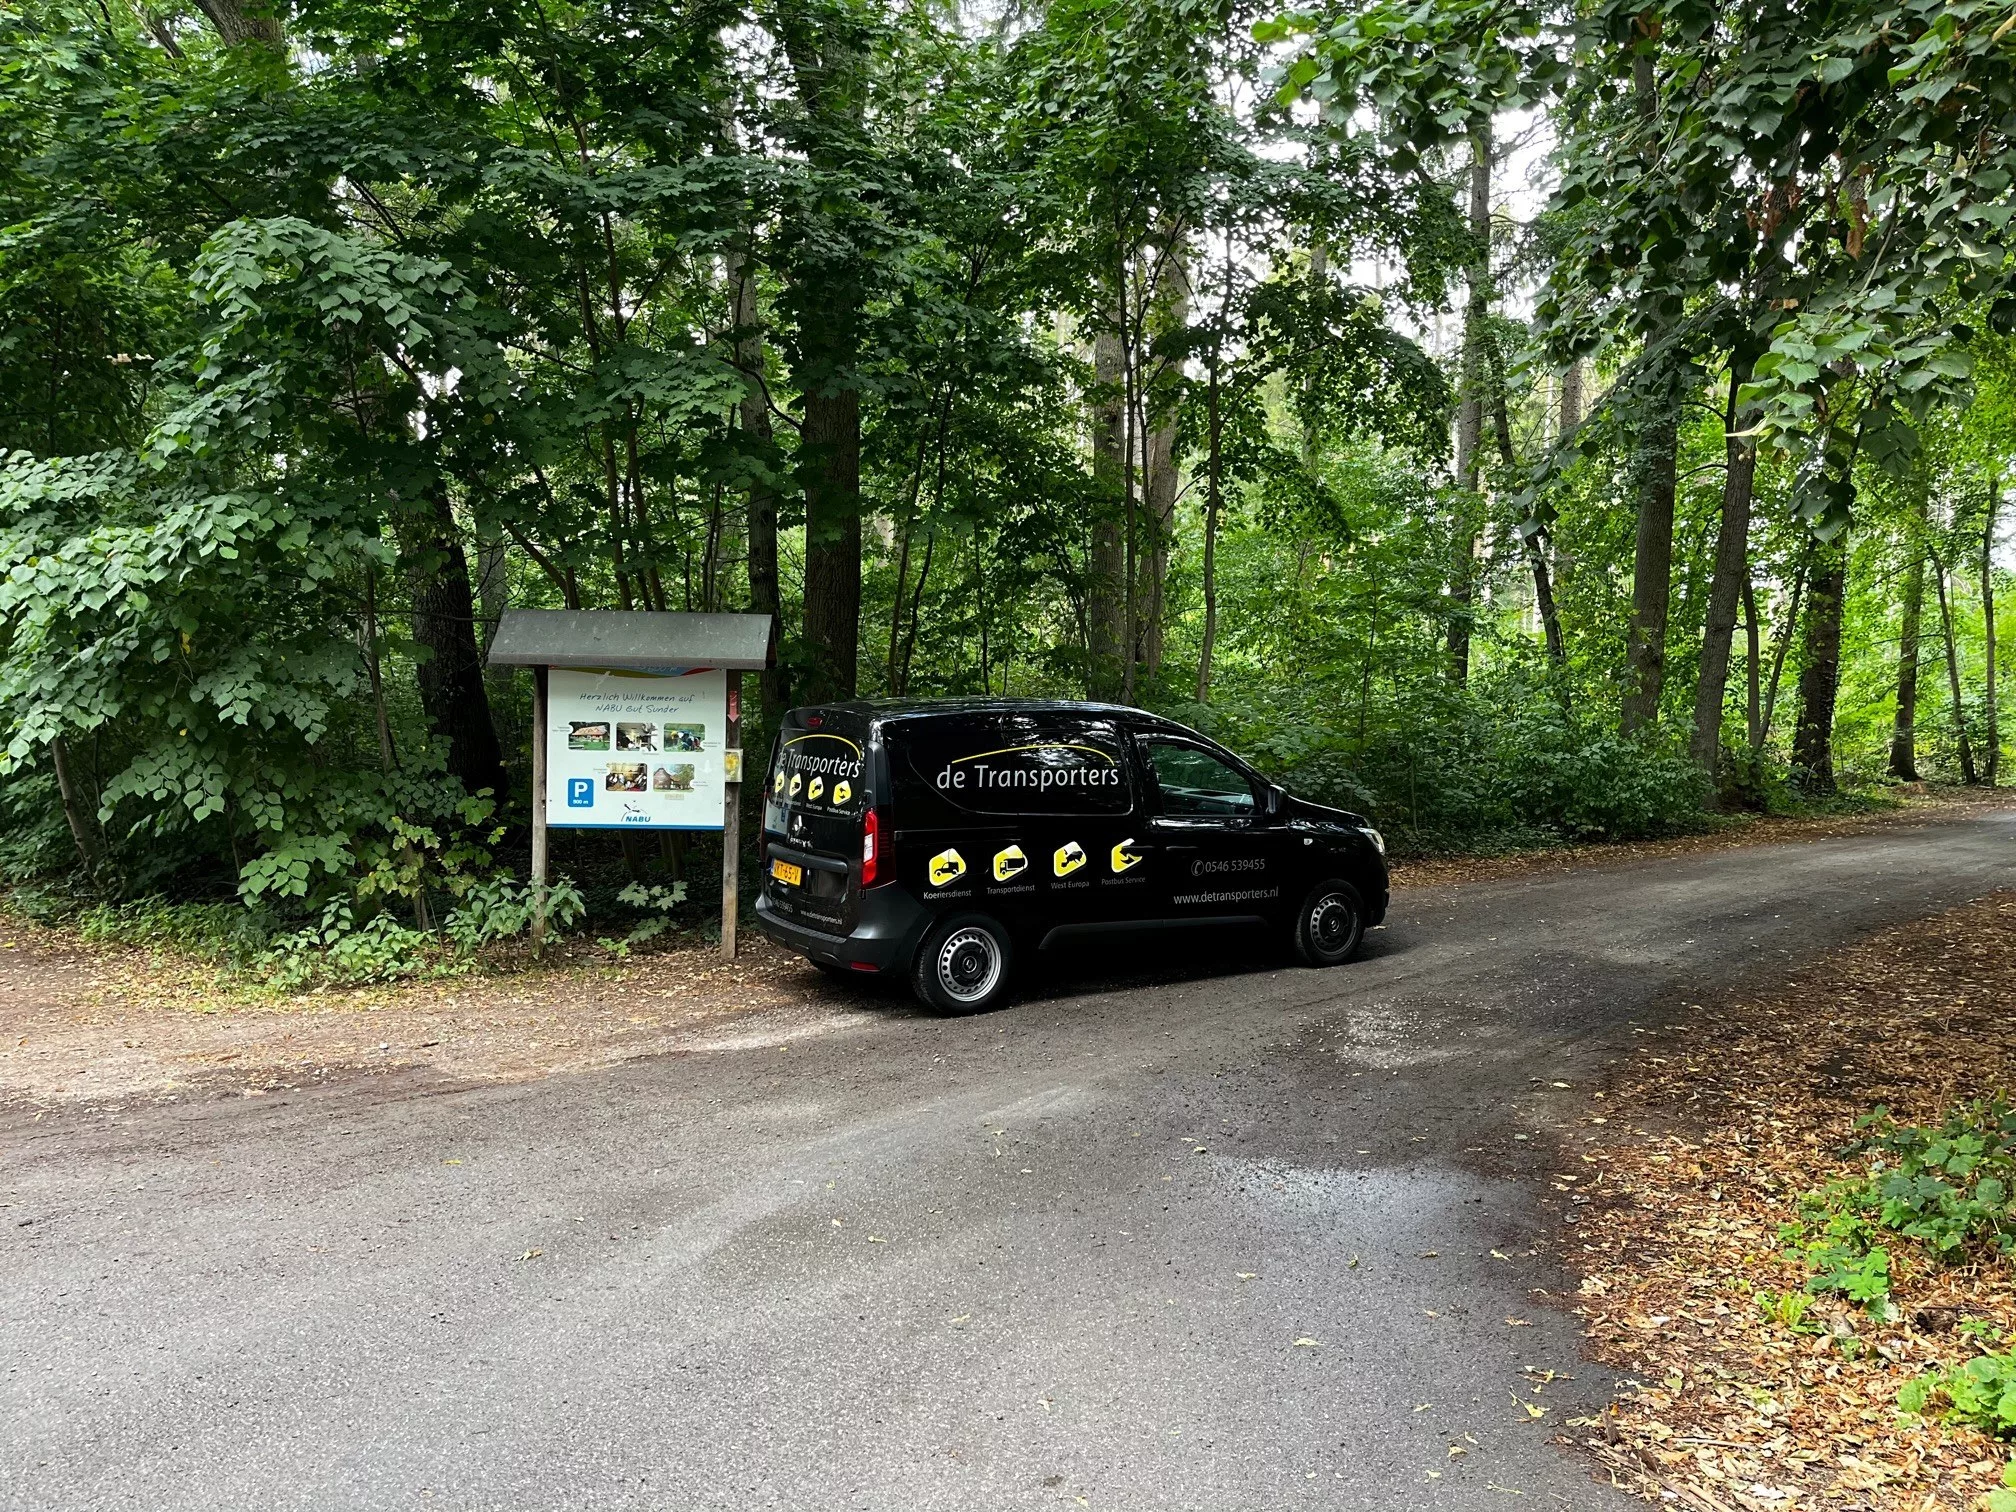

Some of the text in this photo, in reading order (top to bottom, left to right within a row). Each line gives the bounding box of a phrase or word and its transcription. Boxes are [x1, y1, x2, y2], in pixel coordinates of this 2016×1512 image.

[579, 693, 695, 703] Herzlich Willkommen auf
[595, 704, 679, 713] NABU Gut Sunder
[787, 748, 861, 778] Transporters
[936, 765, 1119, 792] de Transporters
[574, 781, 588, 798] P
[1205, 858, 1266, 873] 0546 539455
[1051, 880, 1090, 890] West Europa
[1101, 876, 1146, 886] Postbus Service
[923, 889, 972, 900] Koeriersdienst
[987, 884, 1035, 895] Transportdienst
[1173, 886, 1279, 904] www.detransporters.nl
